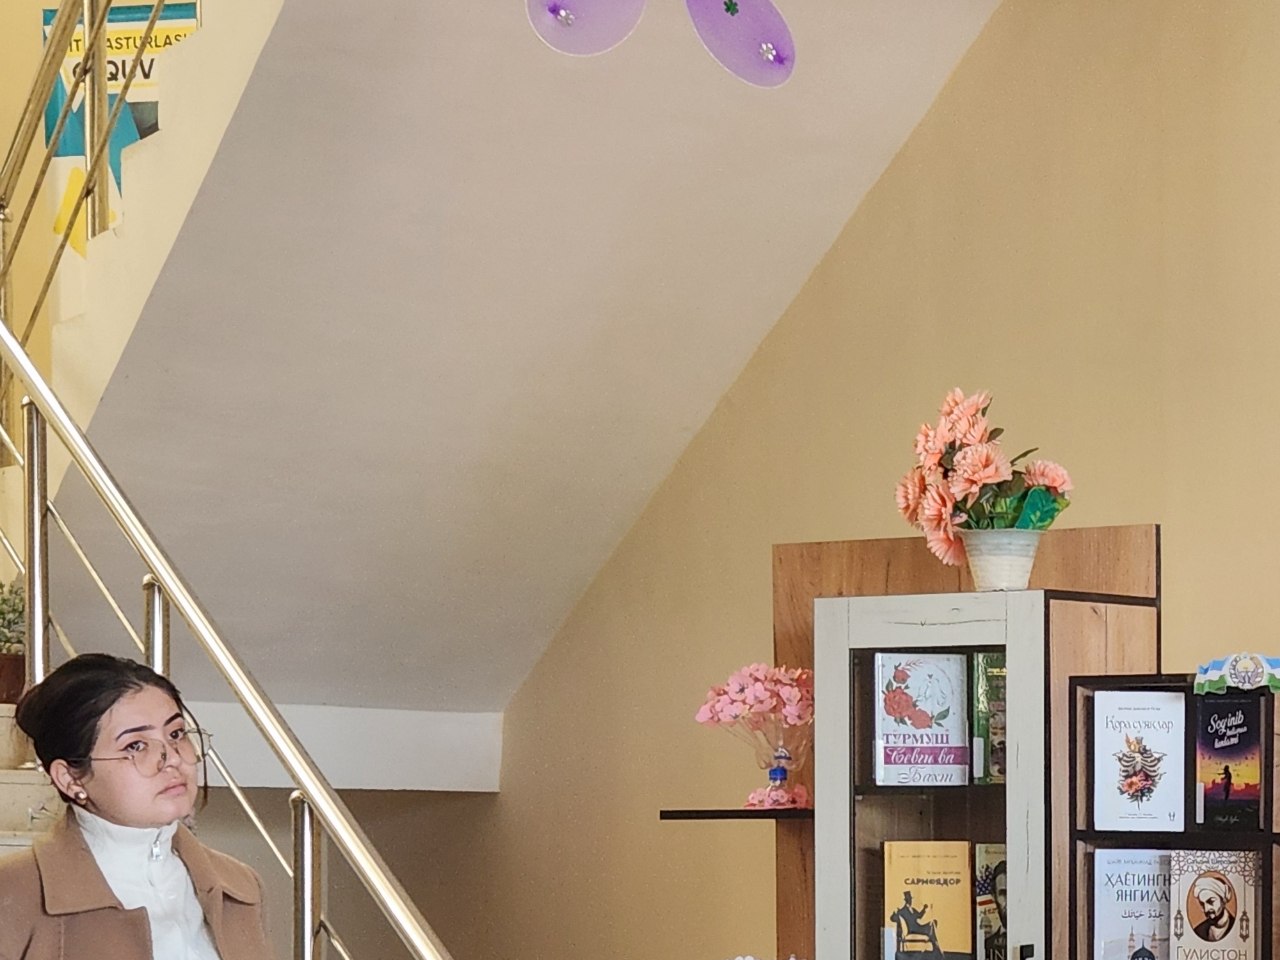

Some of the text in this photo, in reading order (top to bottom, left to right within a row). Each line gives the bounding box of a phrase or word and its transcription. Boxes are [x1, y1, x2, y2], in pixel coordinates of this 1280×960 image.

[106, 33, 188, 51] ASTURLAS
[938, 747, 955, 764] ва
[1104, 872, 1171, 888] ҲАЁТИНГН
[1176, 946, 1248, 960] ГУЛИСТОН
